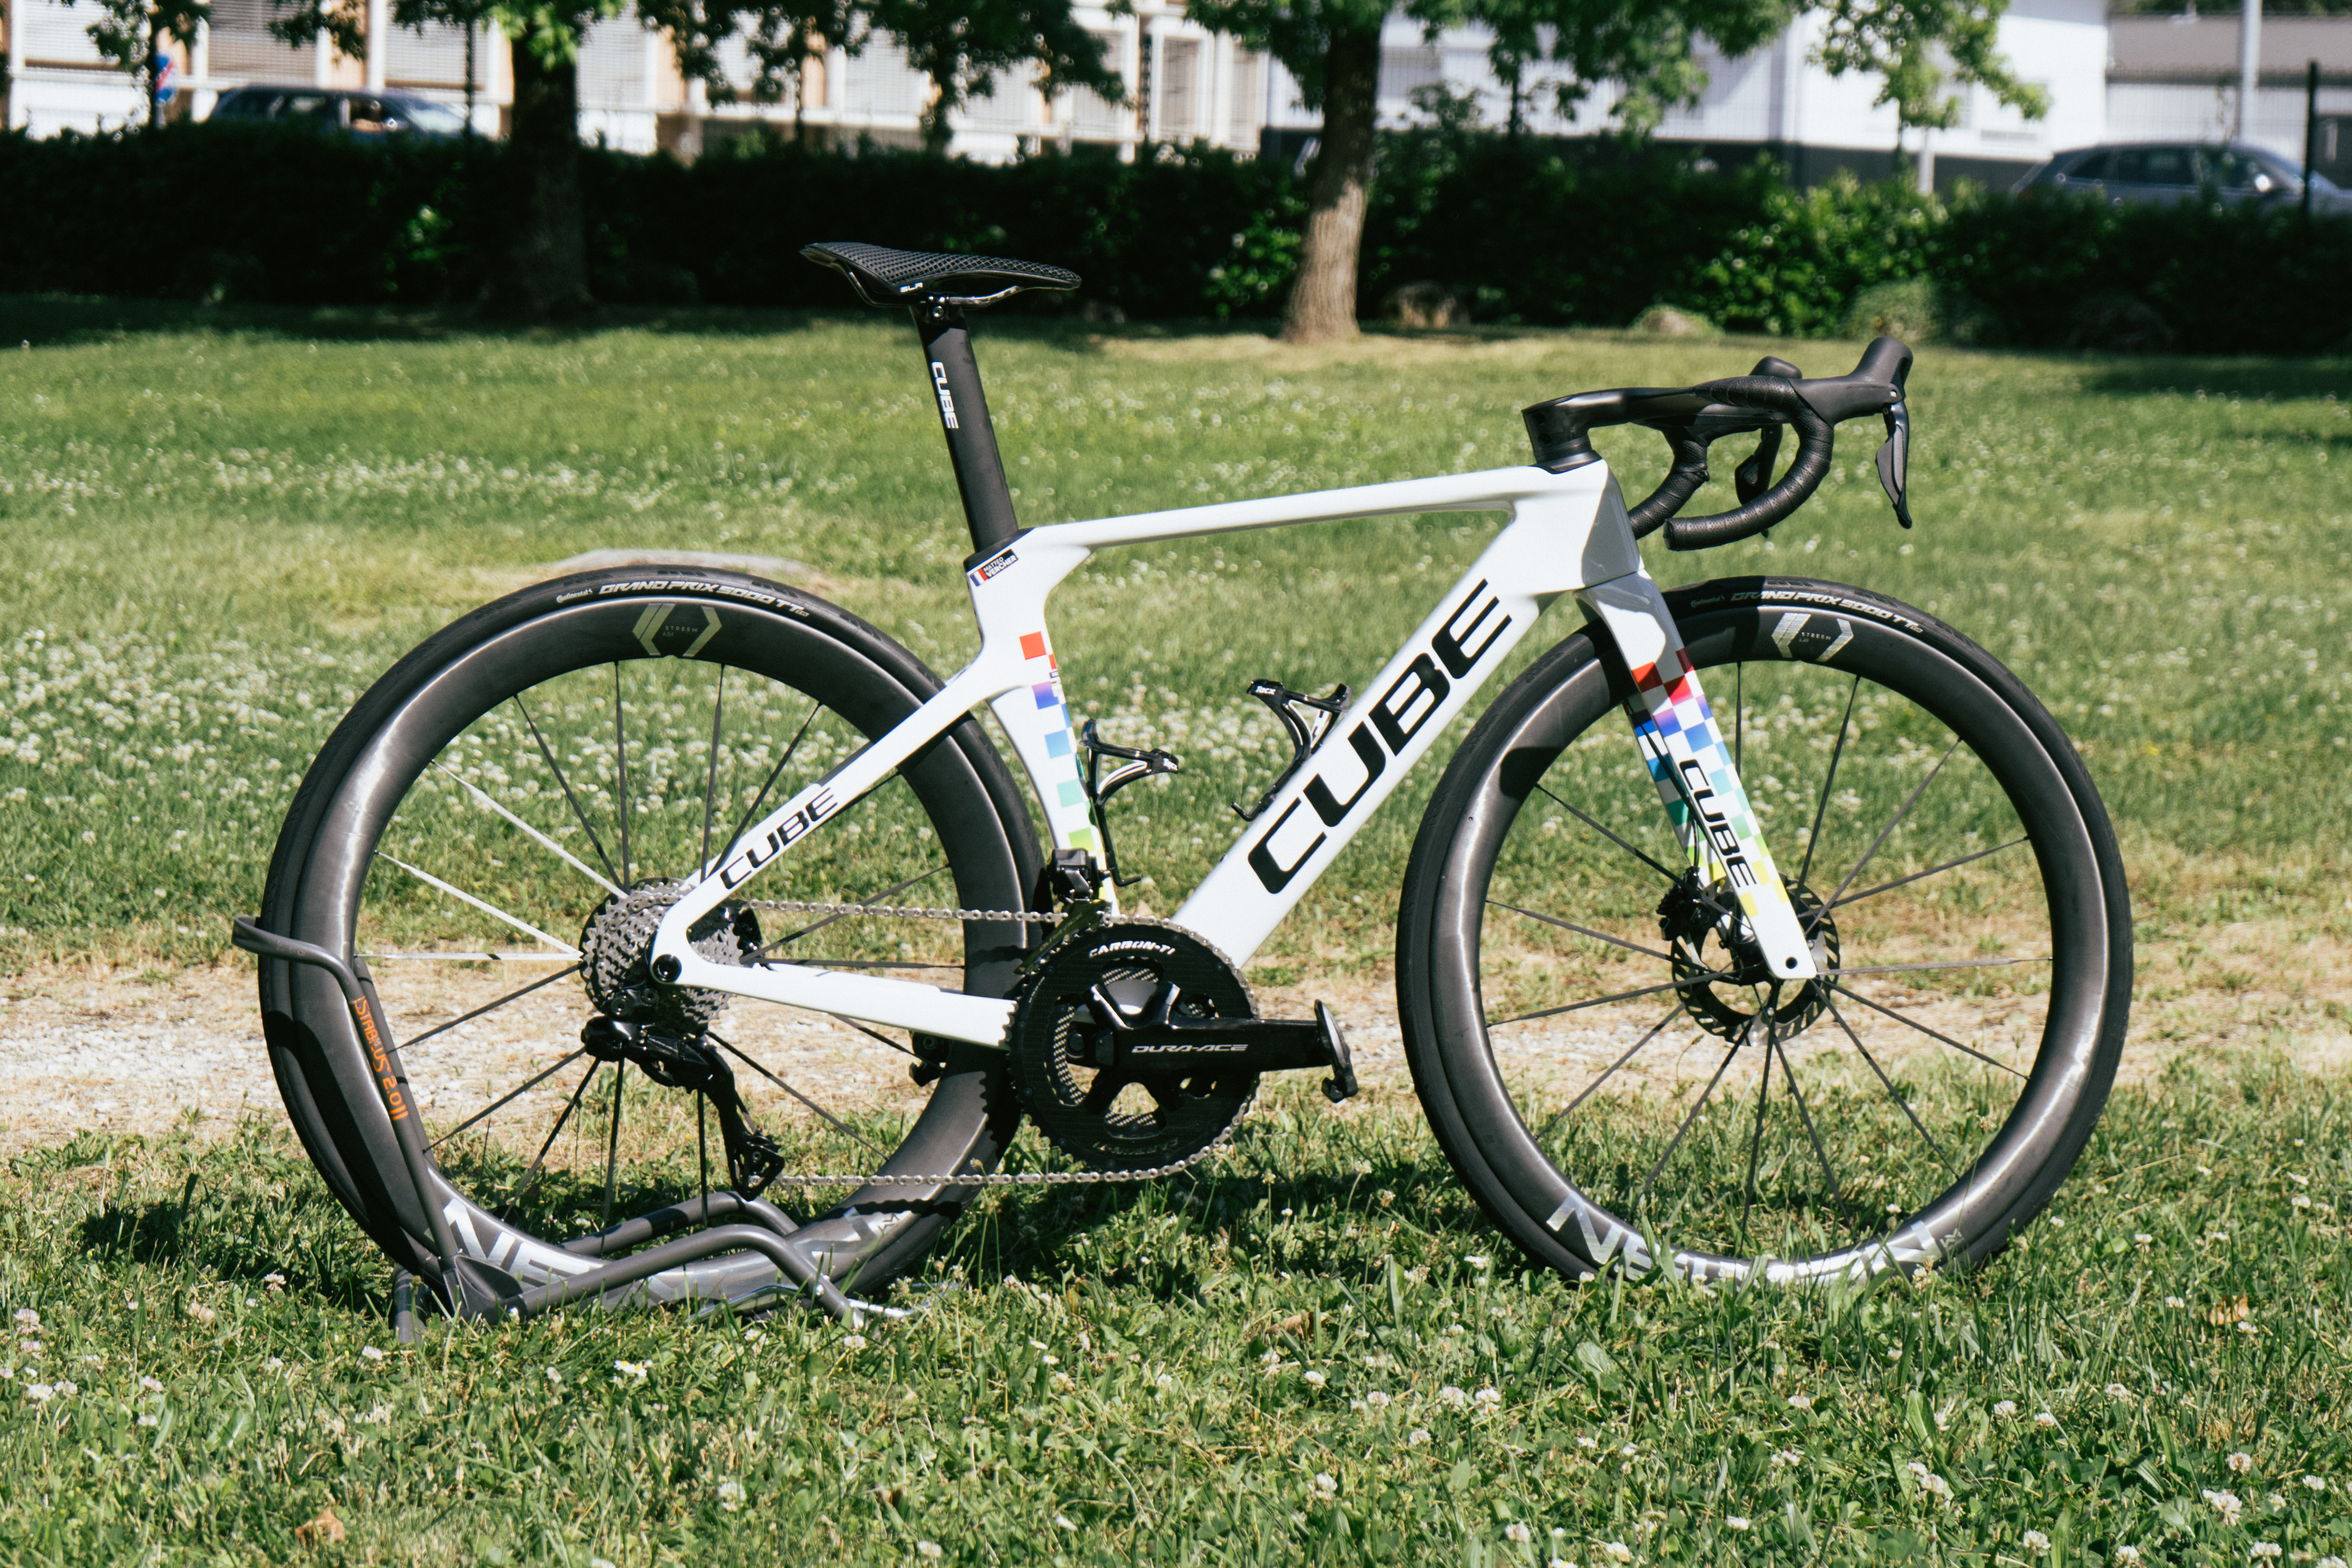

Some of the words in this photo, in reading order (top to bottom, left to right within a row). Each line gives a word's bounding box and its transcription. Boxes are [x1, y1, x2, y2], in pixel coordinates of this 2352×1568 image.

[899, 282, 923, 293] SLR
[931, 361, 959, 429] CUBE
[983, 556, 1004, 573] MATTEO
[985, 555, 1017, 577] VERCHER
[556, 588, 588, 603] Continental
[599, 581, 669, 594] GRAND
[667, 581, 719, 592] PRIX
[716, 585, 776, 604] 5000
[775, 598, 805, 613] TT
[1691, 595, 1721, 608] Continental
[1730, 590, 1796, 601] GRAND
[1793, 592, 1842, 605] PRIX
[1839, 599, 1894, 619] 5000
[1893, 614, 1919, 628] TT
[1801, 632, 1831, 640] STREEM
[1255, 685, 1276, 695] Tacx
[1248, 578, 1512, 894] CUBE
[1679, 759, 1757, 887] CUBE
[719, 787, 838, 890] CUBE
[1131, 1044, 1248, 1053] DURA-ACE
